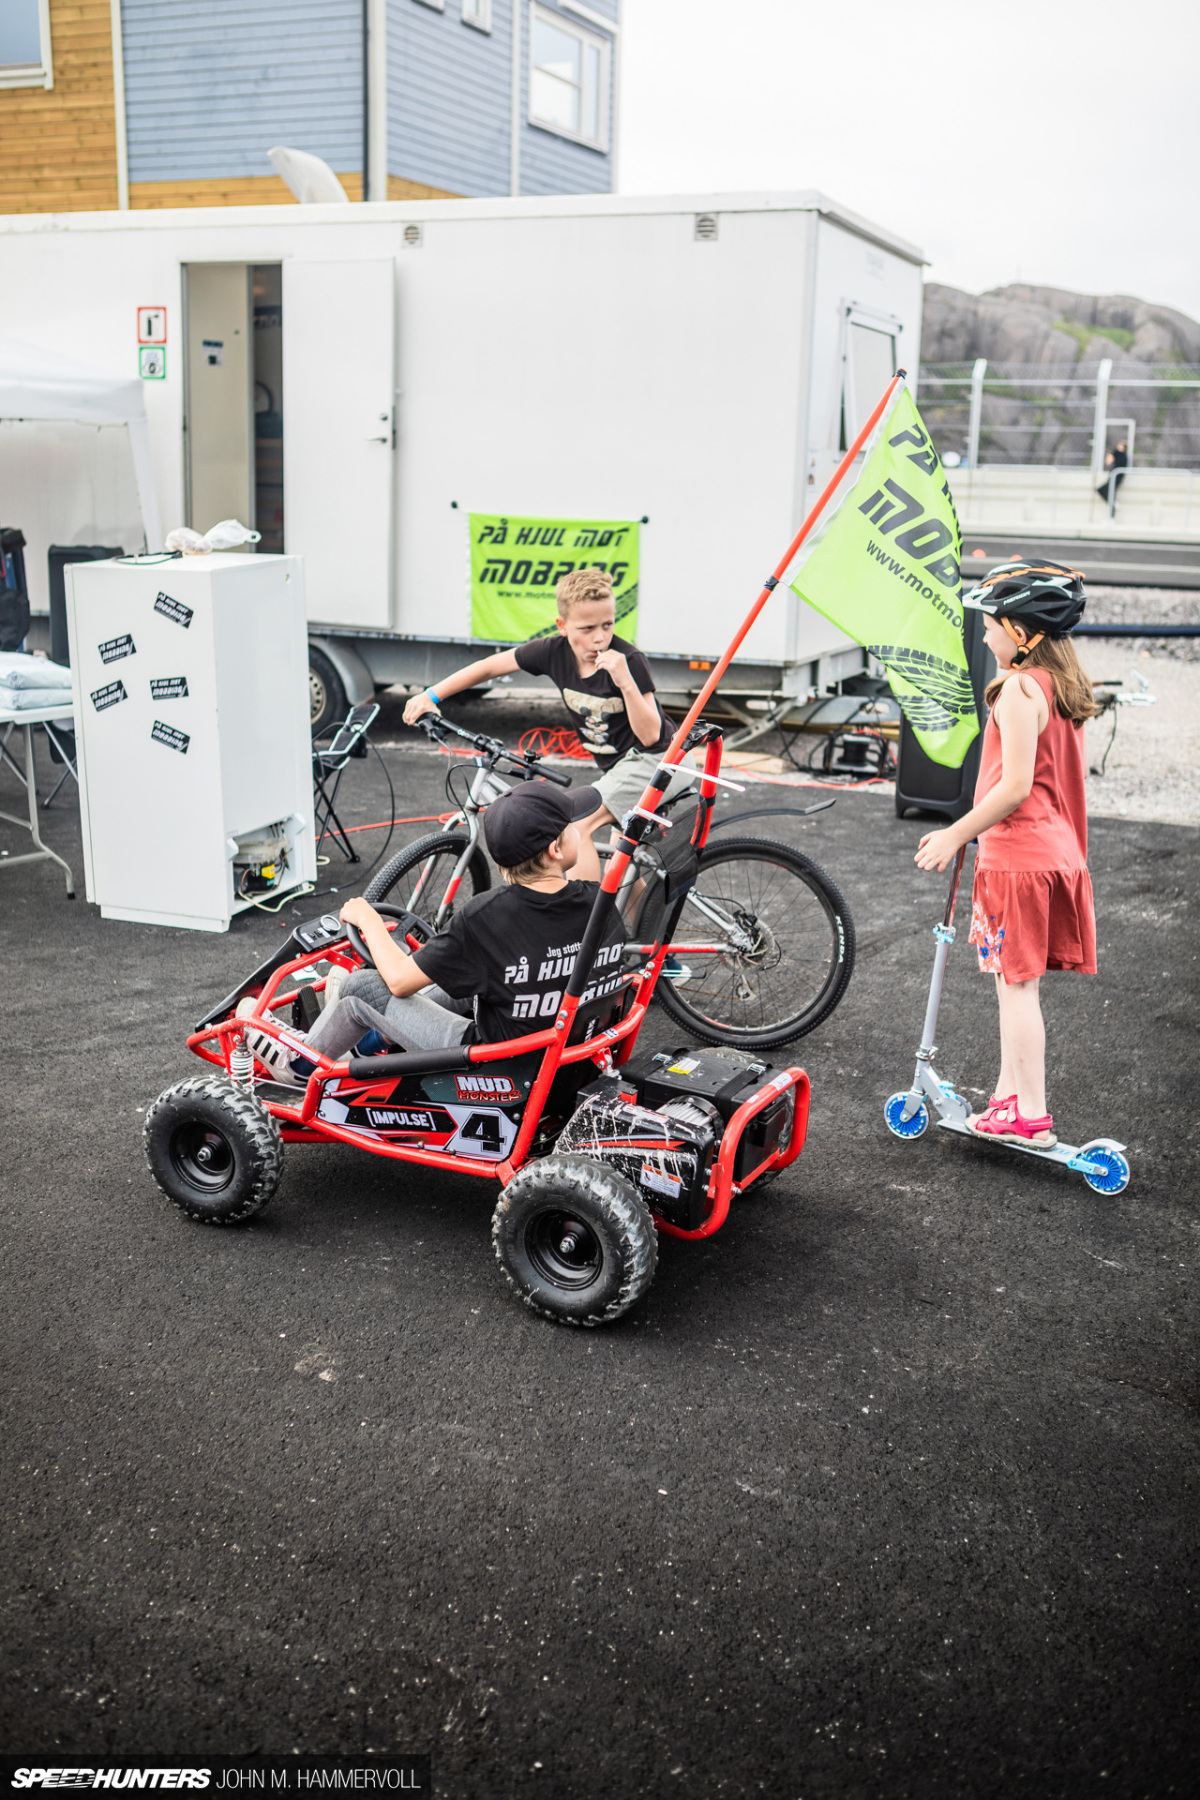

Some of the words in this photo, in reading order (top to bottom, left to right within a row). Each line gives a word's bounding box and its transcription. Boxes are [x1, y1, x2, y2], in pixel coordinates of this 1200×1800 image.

[478, 518, 509, 544] PÅ
[514, 527, 567, 546] HJUL
[573, 527, 630, 548] MOT
[546, 946, 562, 958] Jeg
[835, 915, 846, 964] KENDA
[504, 955, 530, 984] PÅ
[537, 955, 577, 982] HJU
[593, 942, 624, 968] MO
[456, 1076, 513, 1092] MUD
[458, 1090, 521, 1102] MONSTER
[460, 1112, 507, 1154] 4
